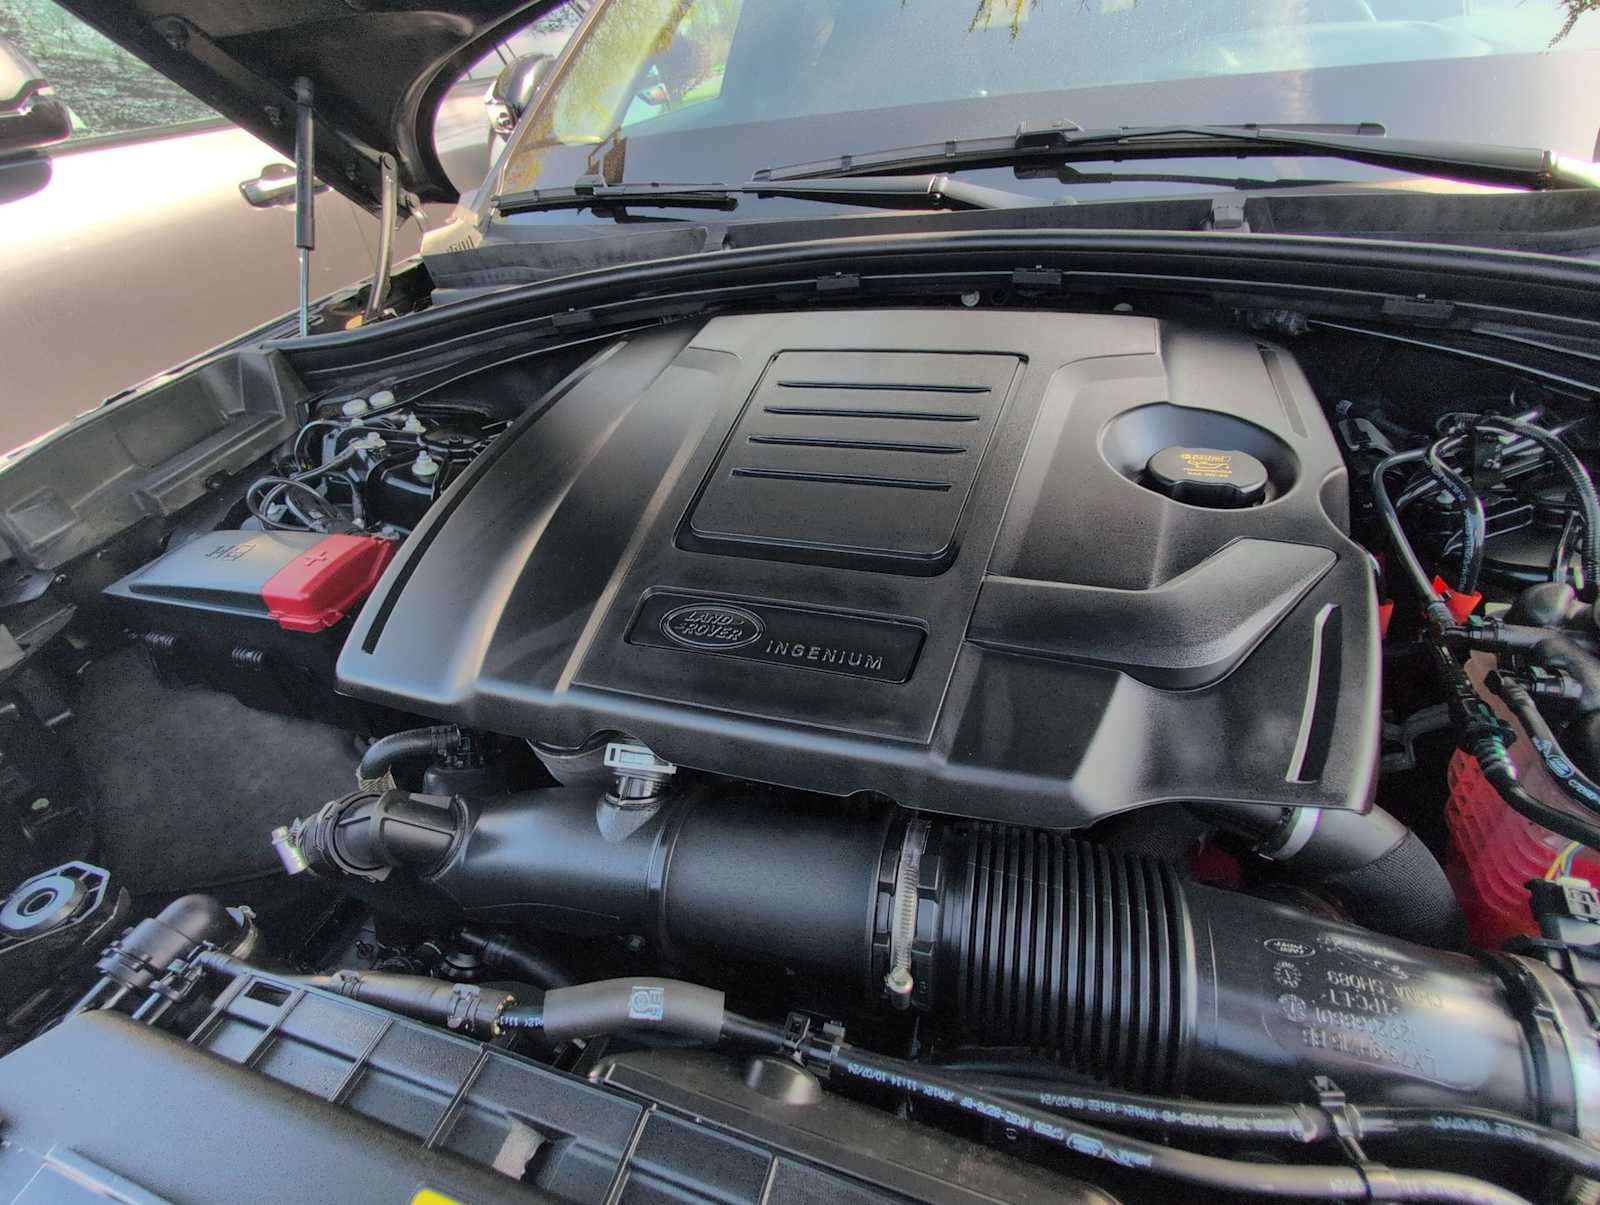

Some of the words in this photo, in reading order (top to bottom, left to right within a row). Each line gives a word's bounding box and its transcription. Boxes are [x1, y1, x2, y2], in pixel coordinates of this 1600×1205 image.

[684, 611, 734, 626] LAND
[681, 623, 743, 641] ROVER
[765, 640, 883, 670] INGENIUM
